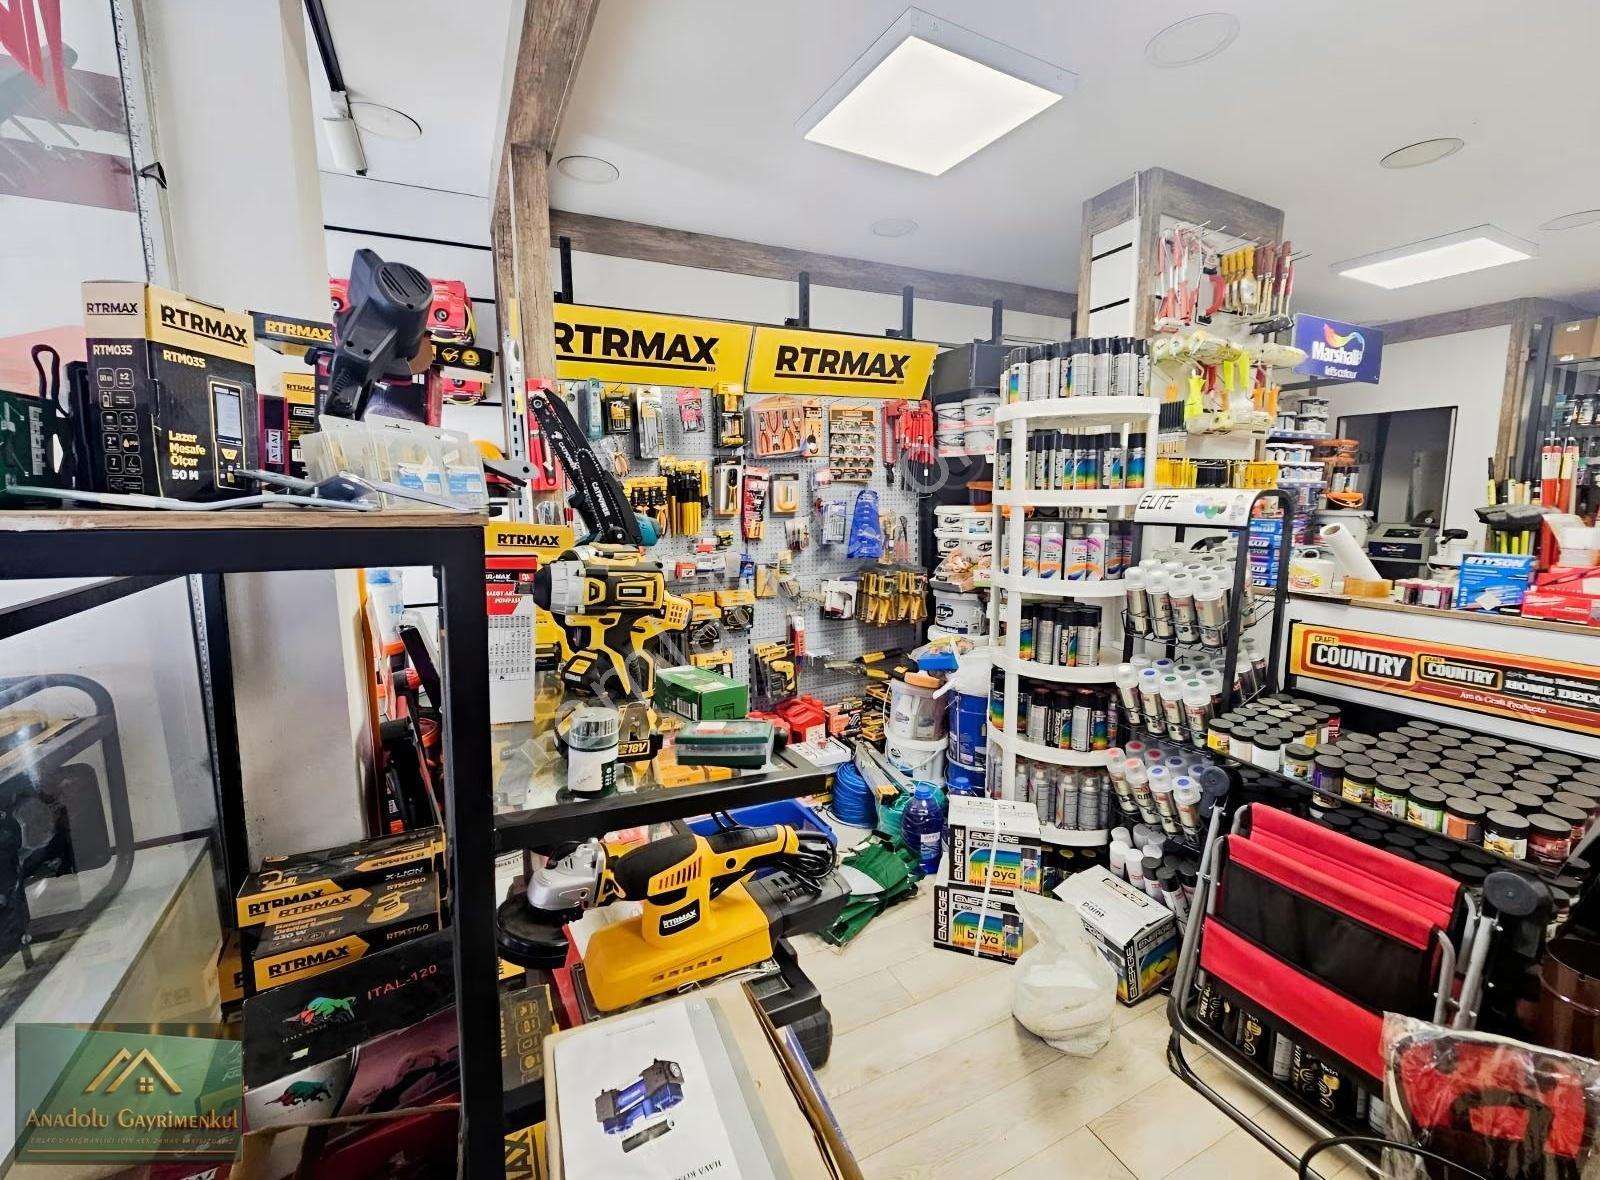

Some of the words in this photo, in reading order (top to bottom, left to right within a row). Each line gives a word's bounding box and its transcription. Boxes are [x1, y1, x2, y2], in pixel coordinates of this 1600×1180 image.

[87, 302, 138, 314] RTRMAX
[161, 303, 248, 344] RTRMAX
[265, 321, 333, 341] RTRMAX
[555, 322, 719, 366] RTRMAX
[1312, 340, 1363, 366] Marshall
[775, 344, 911, 378] RTRMAX
[286, 383, 316, 393] RTRMA
[168, 430, 198, 443] Lazer
[169, 442, 206, 457] Mesafe
[170, 454, 199, 468] Ölçer
[172, 469, 188, 481] 50
[189, 470, 199, 481] M
[1138, 495, 1179, 510] ELITE
[497, 533, 560, 546] RTRMAX
[1316, 645, 1407, 677] COUNTRY
[1427, 662, 1495, 685] COUNTRY
[1504, 679, 1555, 696] HOME
[628, 742, 646, 755] 18V
[954, 829, 965, 881] ENERGE
[385, 866, 424, 881] X-LION
[247, 889, 324, 915] RTRMAX
[278, 895, 353, 918] RTRMAX
[1081, 901, 1106, 919] paint
[663, 909, 697, 928] RTRMAX
[938, 890, 948, 941] ENERGE
[268, 944, 349, 978] RTRMAX
[1126, 945, 1138, 999] ENERGE
[367, 964, 437, 1001] ITAL-120
